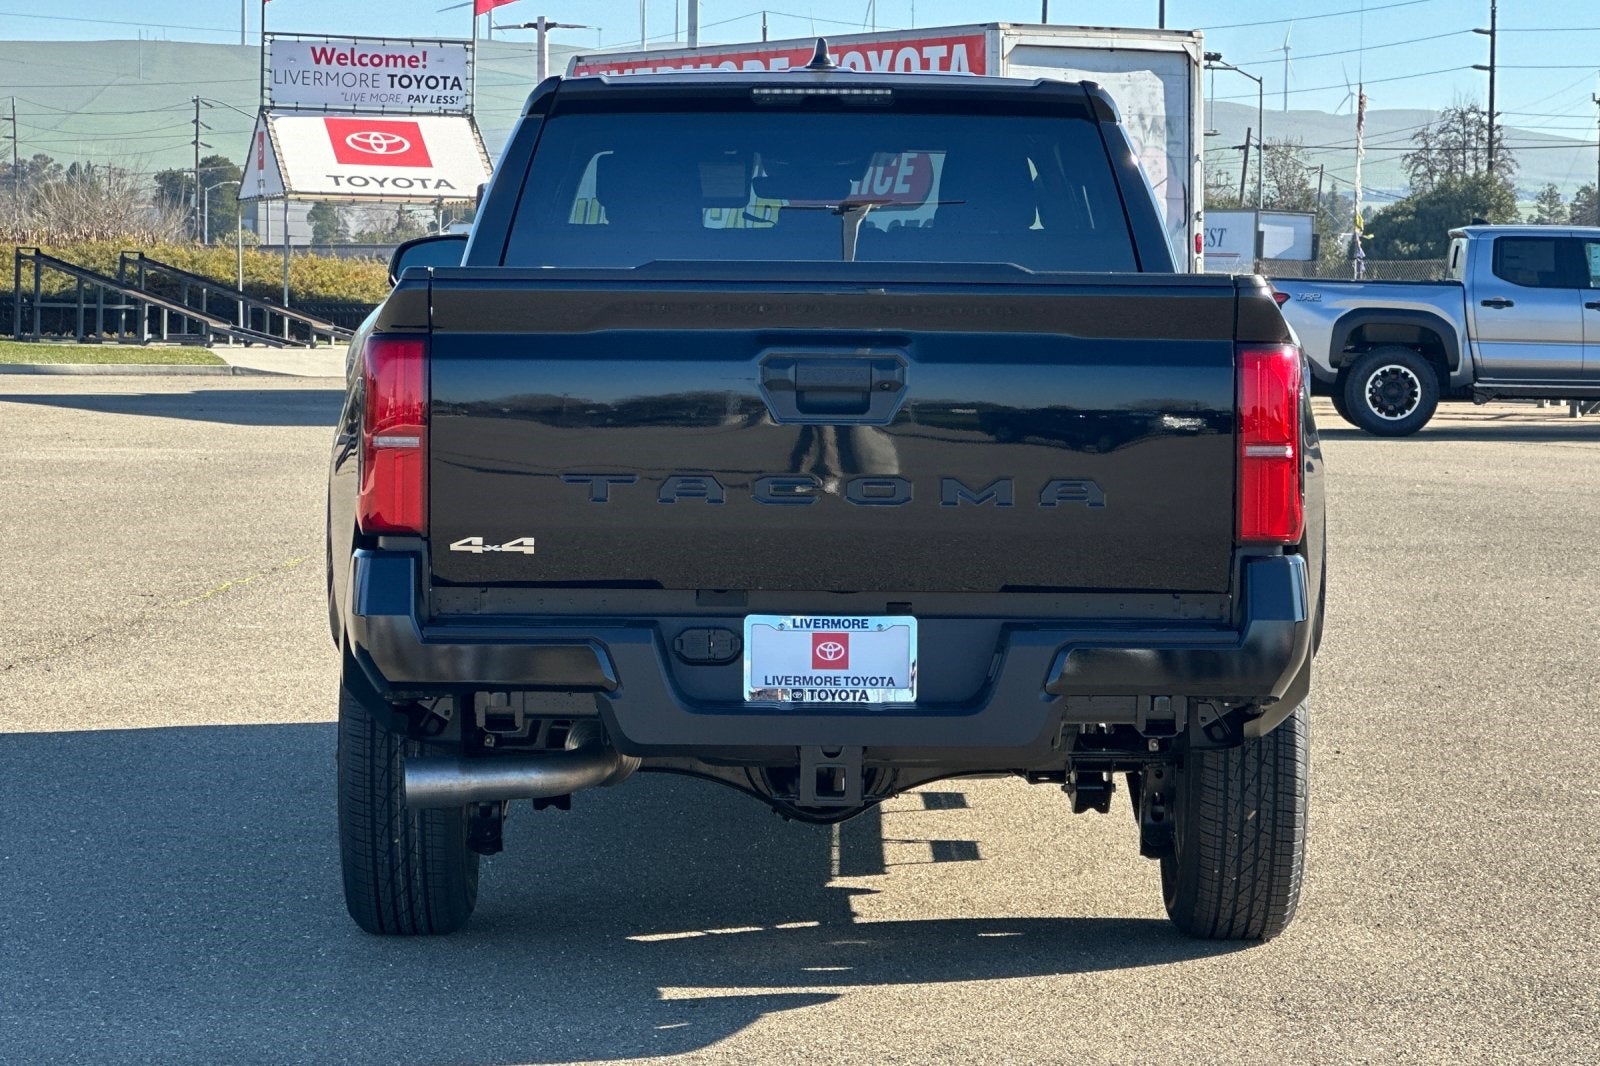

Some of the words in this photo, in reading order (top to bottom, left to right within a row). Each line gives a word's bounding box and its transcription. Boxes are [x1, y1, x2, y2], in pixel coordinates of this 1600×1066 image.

[310, 46, 428, 69] Welcome!
[829, 43, 970, 73] OYOTA
[273, 69, 381, 89] LIVERMORE
[387, 73, 463, 91] TOYOTA
[369, 93, 404, 105] MORE,
[407, 94, 428, 104] PAY
[325, 174, 457, 191] TOYOTA
[558, 473, 1107, 508] TACOMA
[449, 535, 536, 556] 4x4
[792, 618, 869, 630] LIVERMORE
[764, 675, 841, 687] LIVERMORE
[844, 675, 896, 688] TOYOTA
[808, 689, 870, 702] TOYOTA
